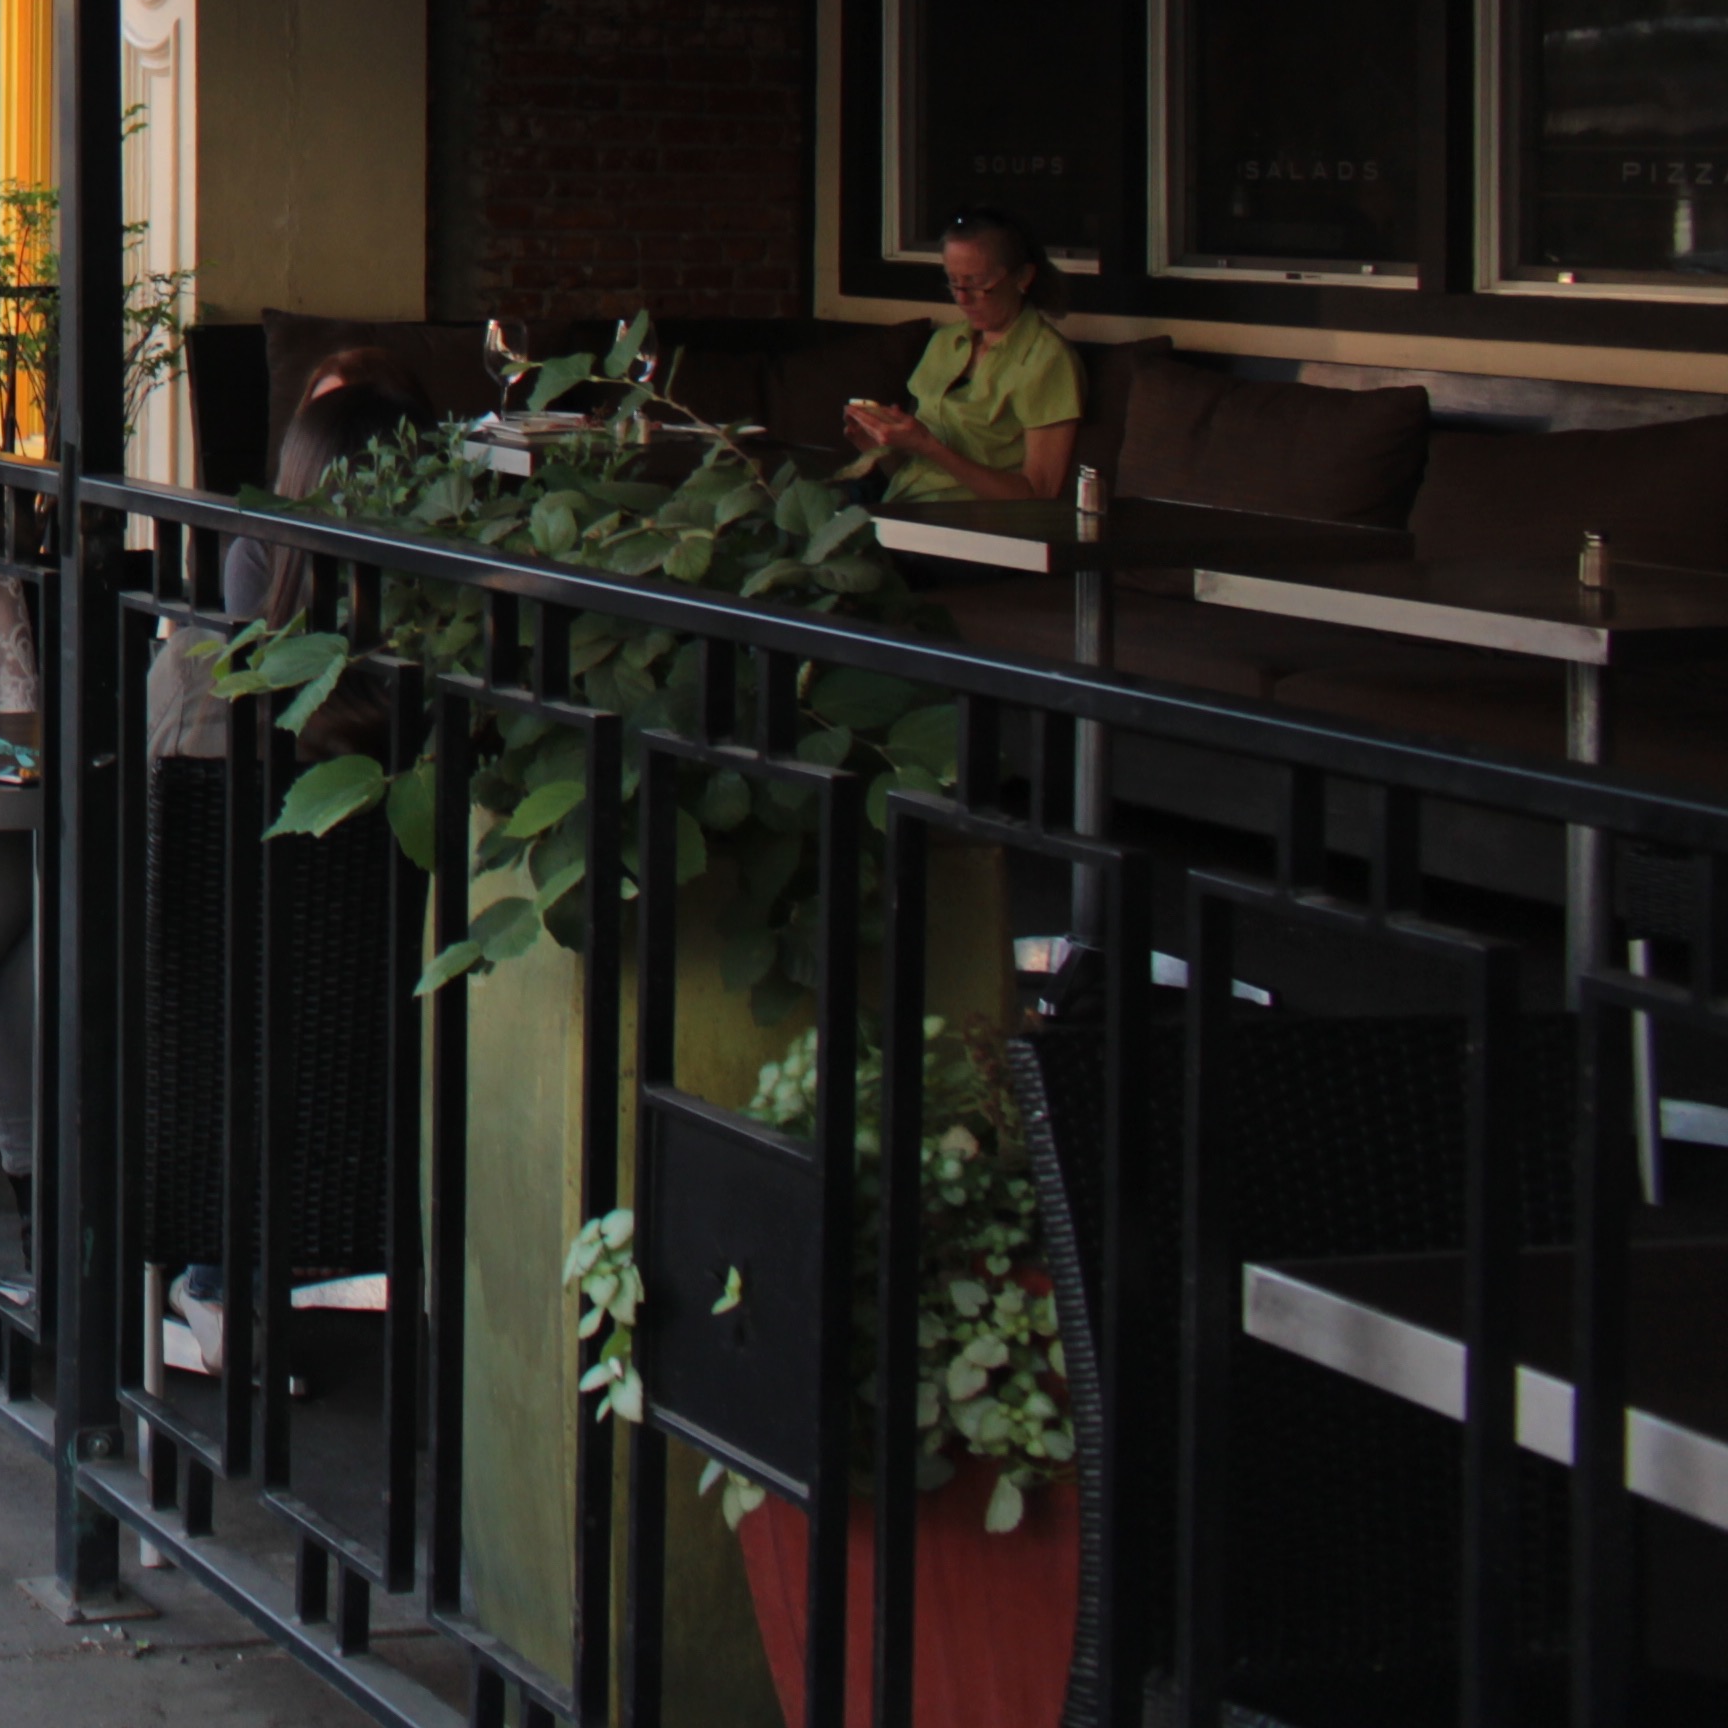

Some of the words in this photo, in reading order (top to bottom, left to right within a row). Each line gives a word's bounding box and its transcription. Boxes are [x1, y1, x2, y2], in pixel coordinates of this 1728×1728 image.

[974, 155, 1065, 175] SOUPS
[1244, 159, 1380, 181] SALADS
[1622, 161, 1728, 185] PIZZ
